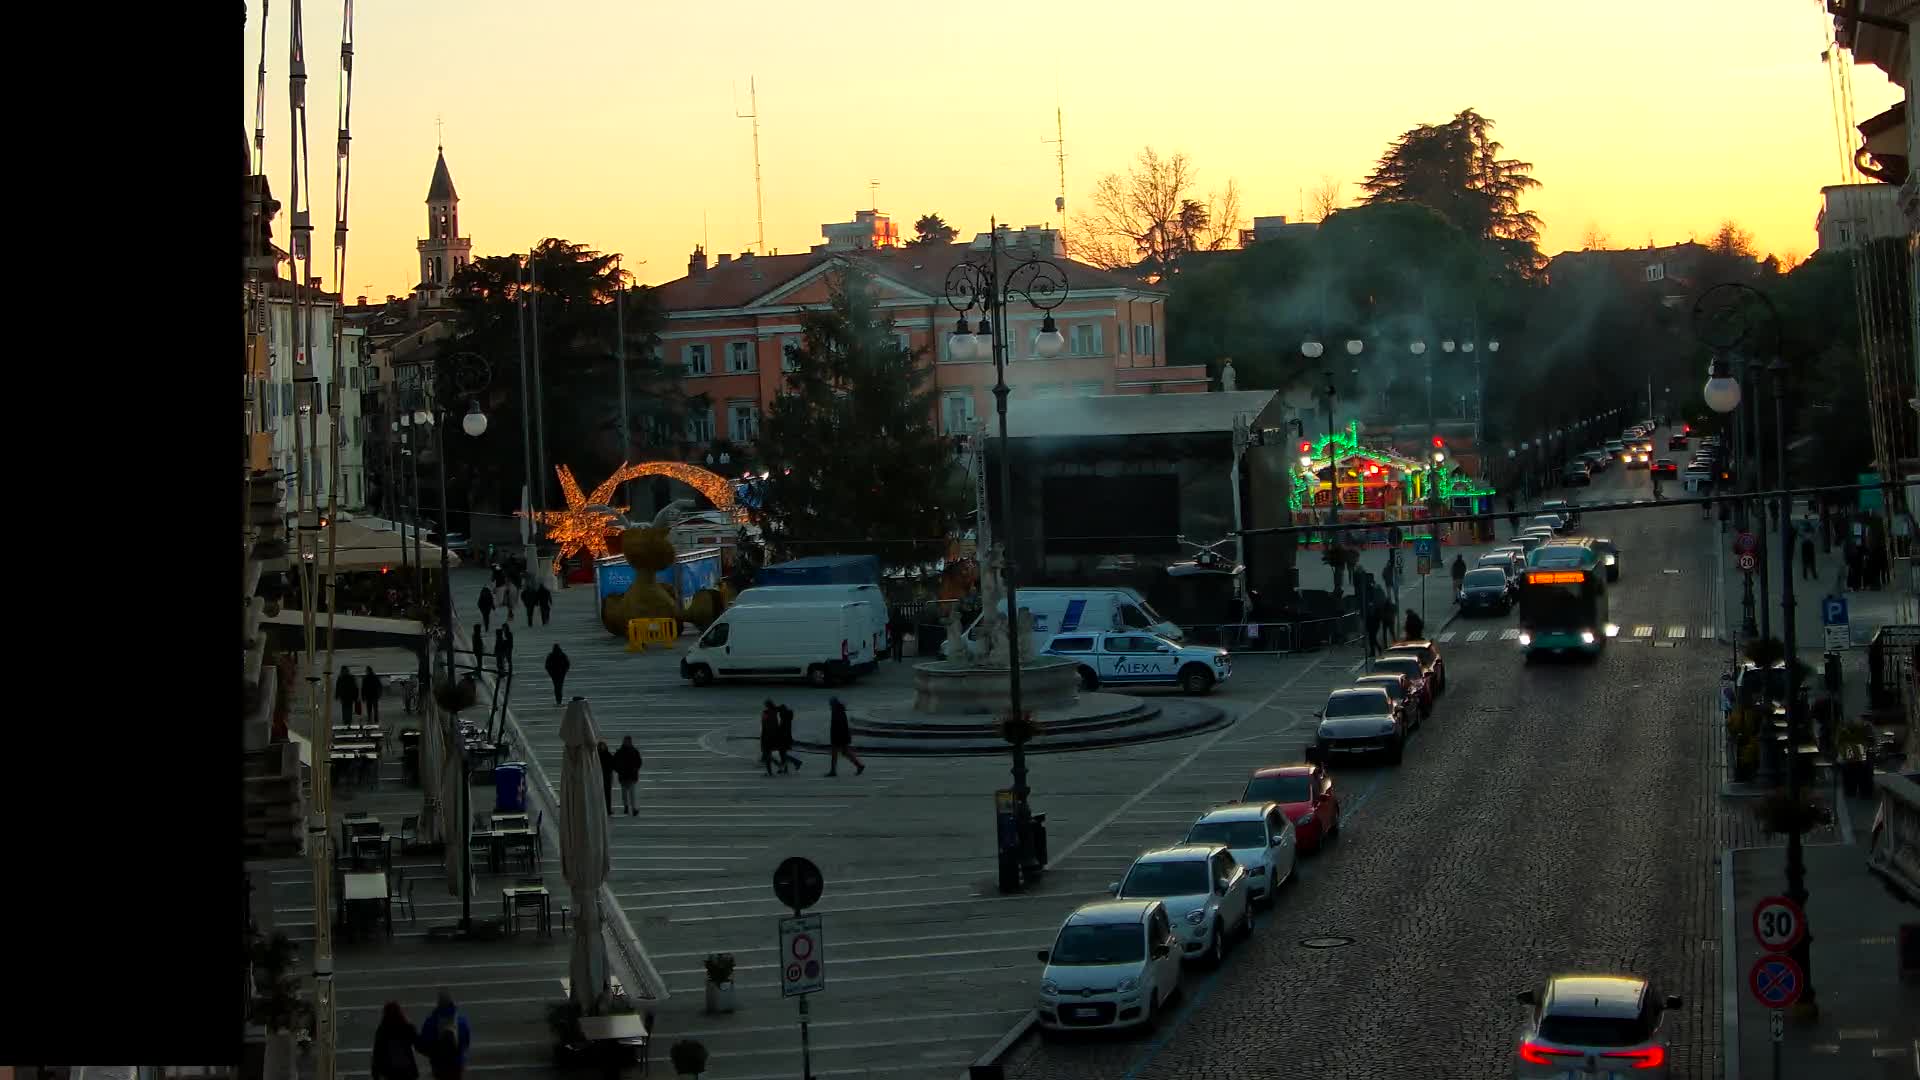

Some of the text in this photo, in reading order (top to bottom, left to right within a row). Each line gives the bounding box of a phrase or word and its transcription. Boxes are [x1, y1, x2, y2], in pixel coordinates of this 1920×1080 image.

[1743, 557, 1753, 567] 20
[1827, 602, 1842, 623] P
[1116, 662, 1161, 674] ALEXA
[1762, 911, 1792, 938] 30
